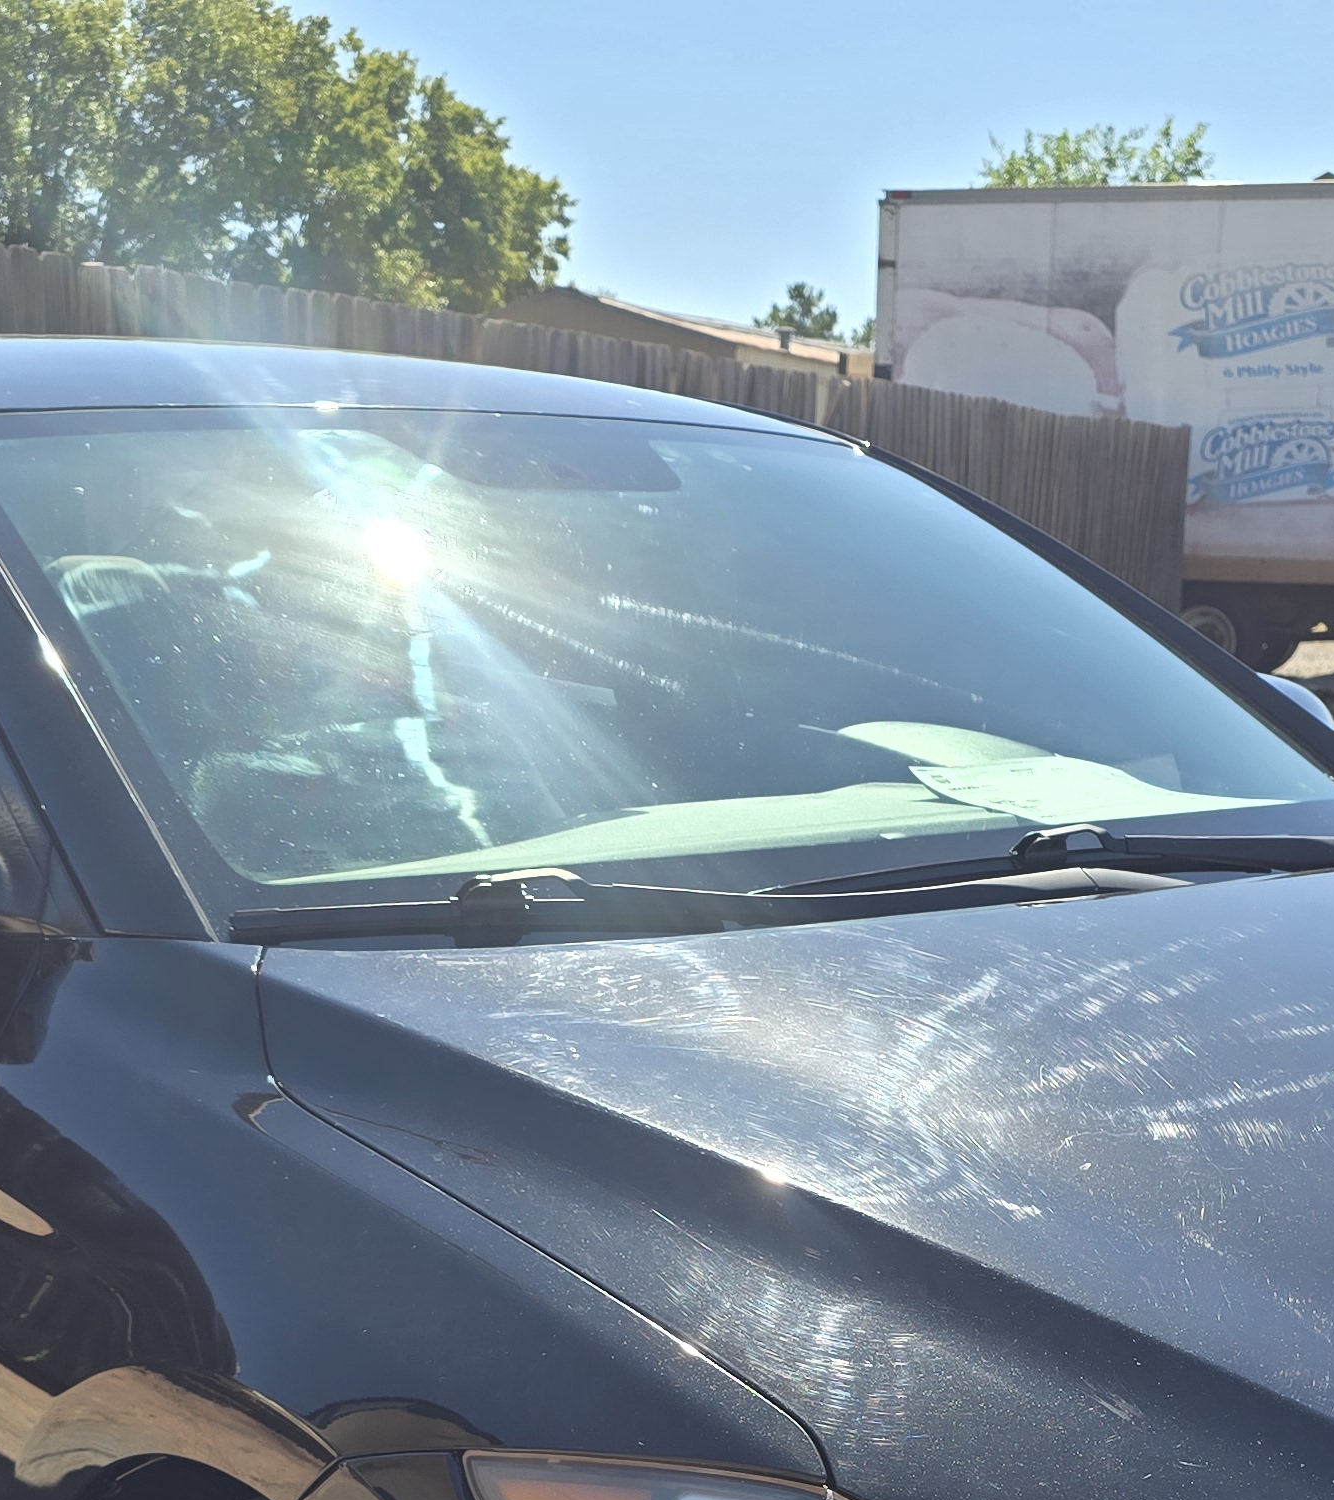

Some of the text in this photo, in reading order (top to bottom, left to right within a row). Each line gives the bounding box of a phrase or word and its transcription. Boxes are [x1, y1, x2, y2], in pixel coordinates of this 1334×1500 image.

[1207, 289, 1267, 331] Mill
[1226, 316, 1317, 352] HOAGIES
[1218, 445, 1268, 480] Mill
